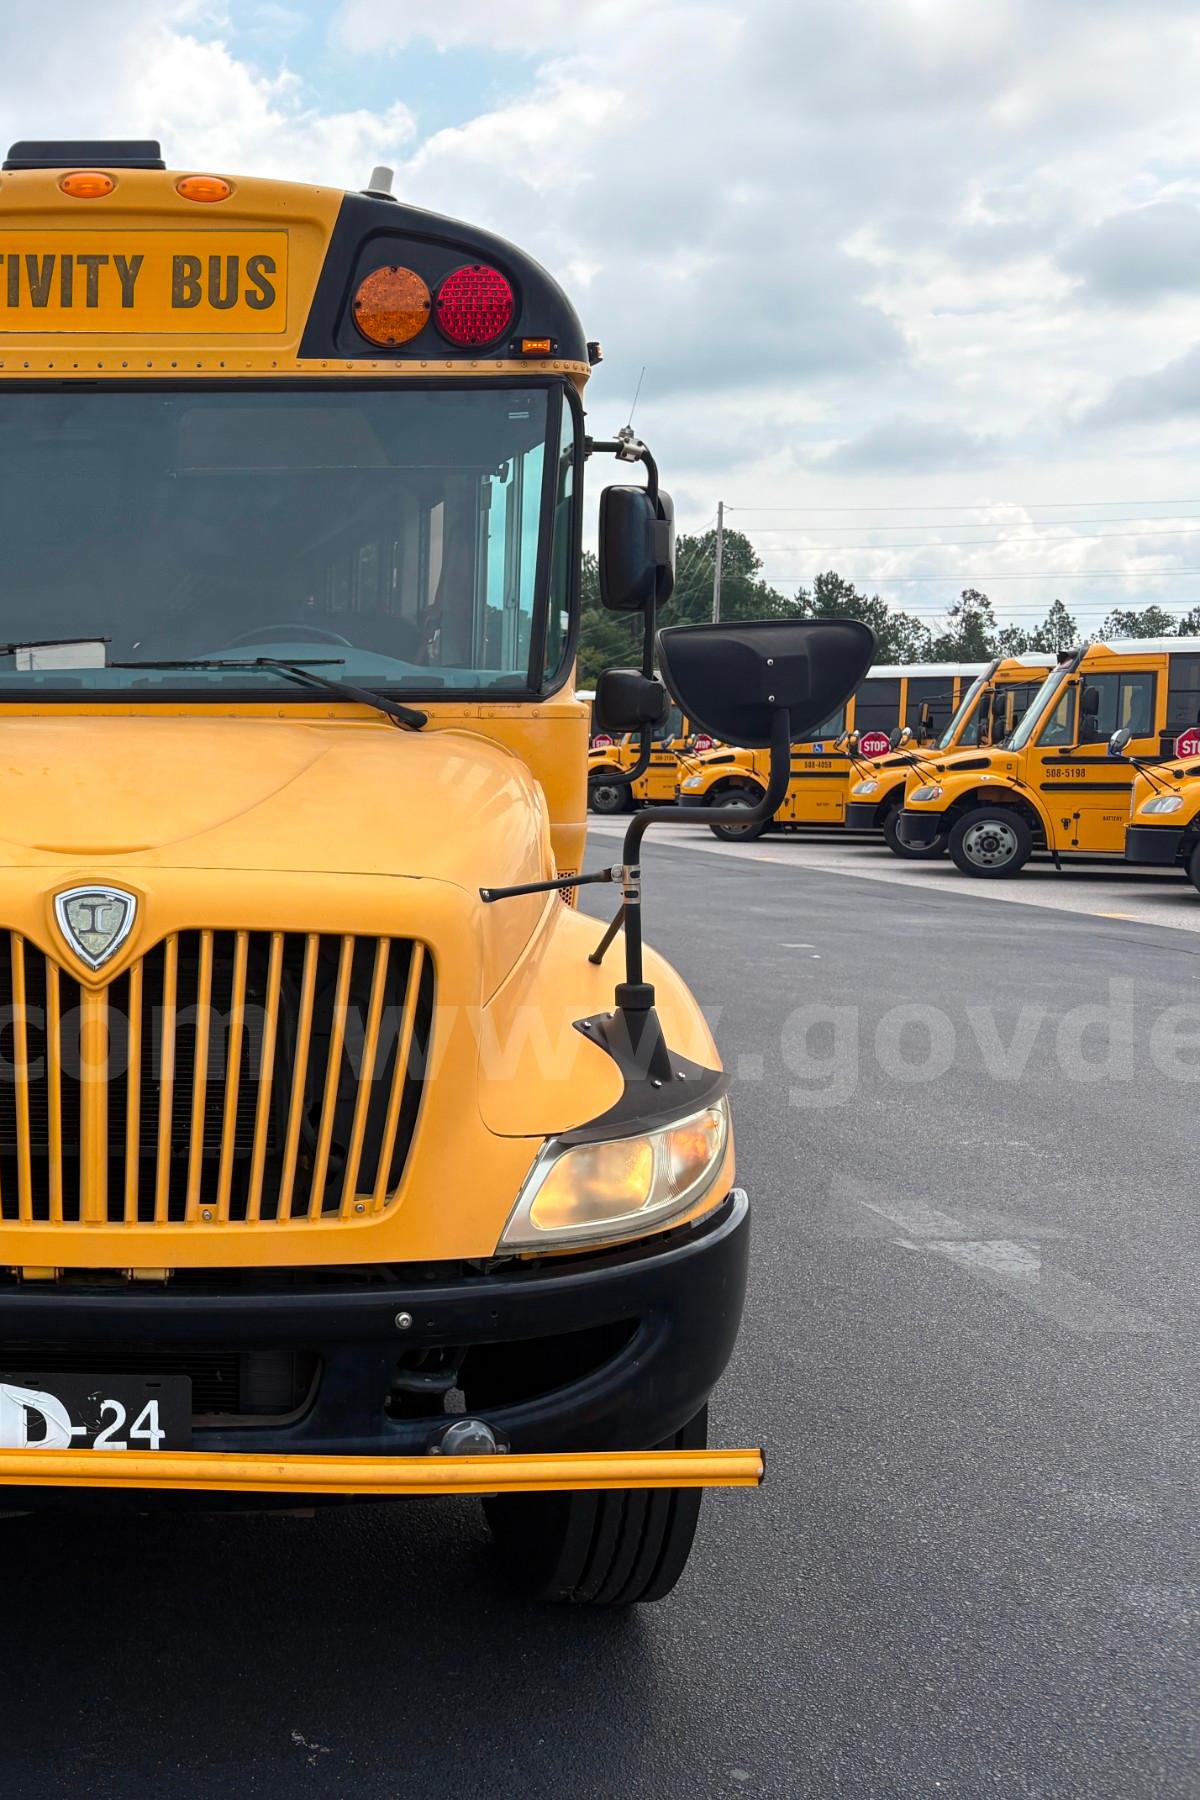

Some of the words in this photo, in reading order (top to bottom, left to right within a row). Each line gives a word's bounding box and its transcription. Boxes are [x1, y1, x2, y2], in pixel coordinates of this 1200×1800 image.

[171, 254, 277, 310] BUS
[863, 740, 887, 752] STOP
[1045, 768, 1086, 778] 508-5198
